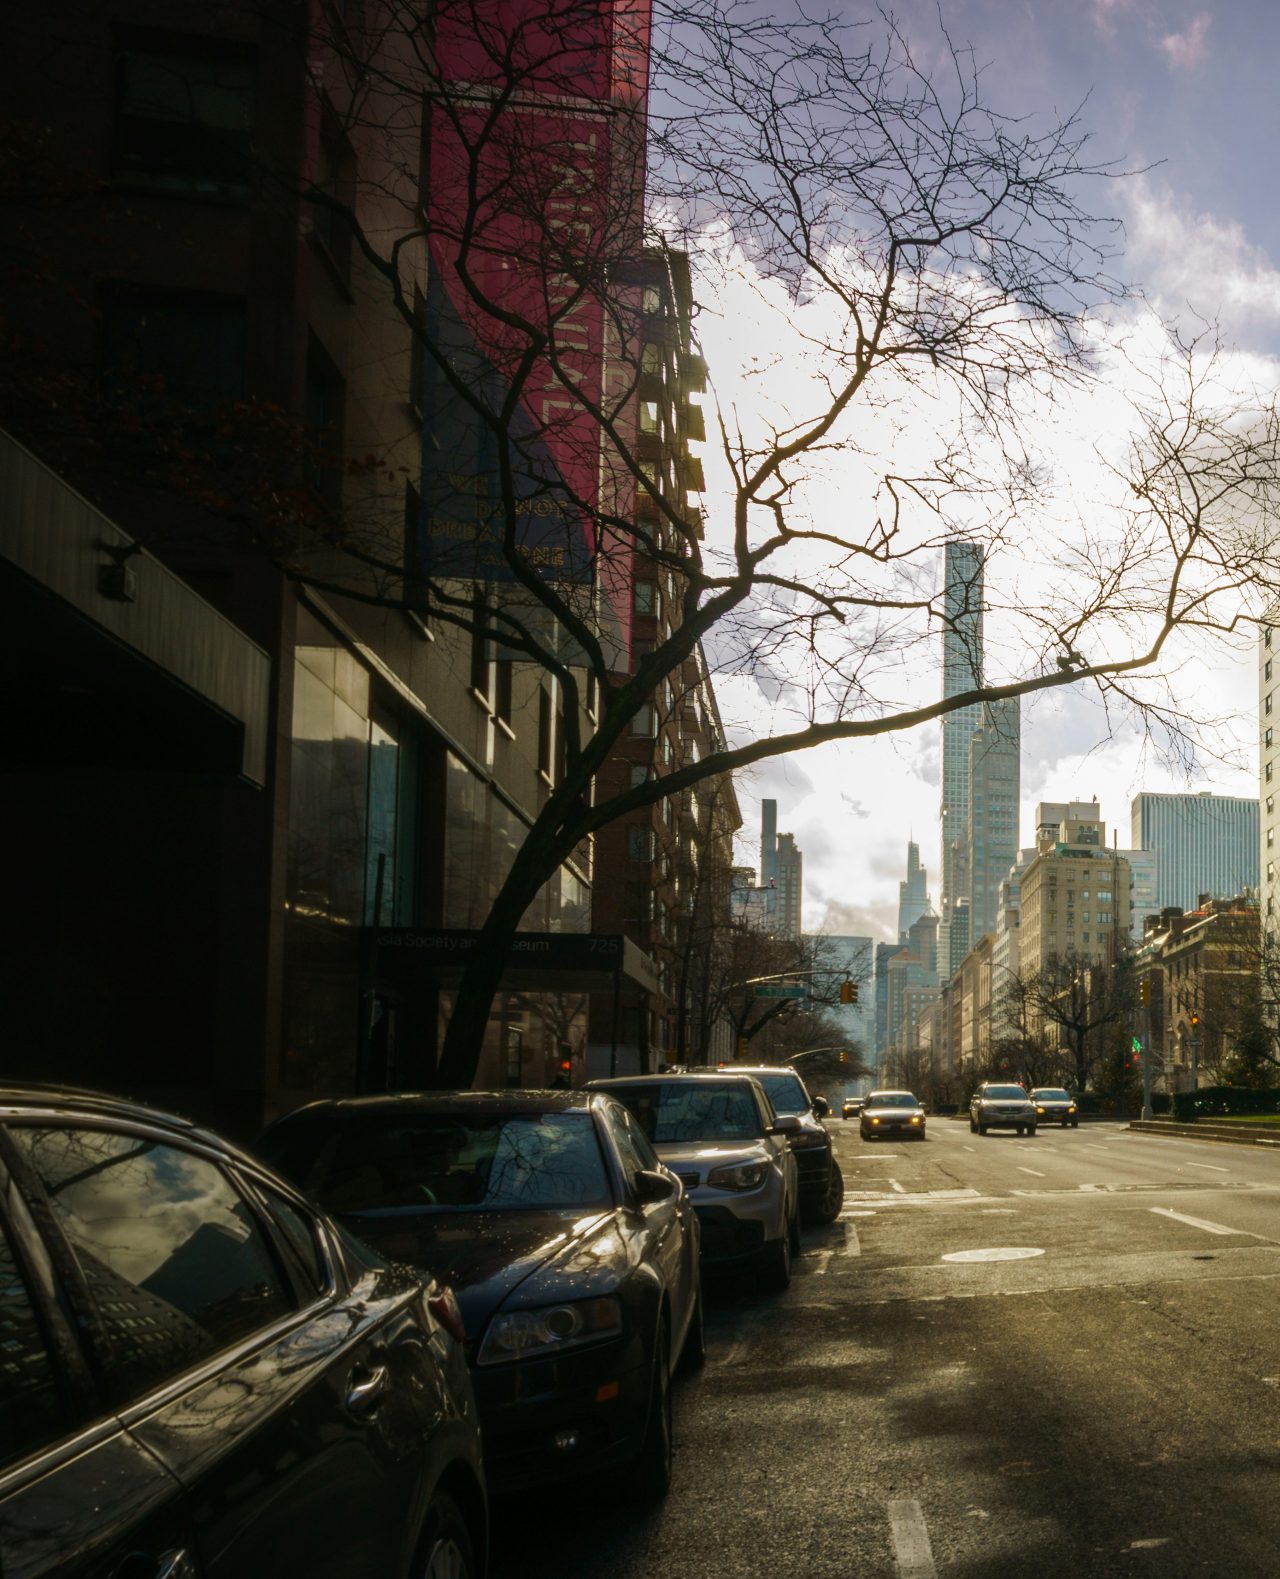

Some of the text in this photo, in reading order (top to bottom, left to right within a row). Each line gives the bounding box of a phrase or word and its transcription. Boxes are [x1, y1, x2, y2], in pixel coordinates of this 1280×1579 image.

[543, 134, 598, 426] TRIENNIAL
[448, 472, 489, 496] WE
[513, 498, 568, 519] NOT
[405, 932, 457, 950] Society
[588, 938, 618, 953] 725
